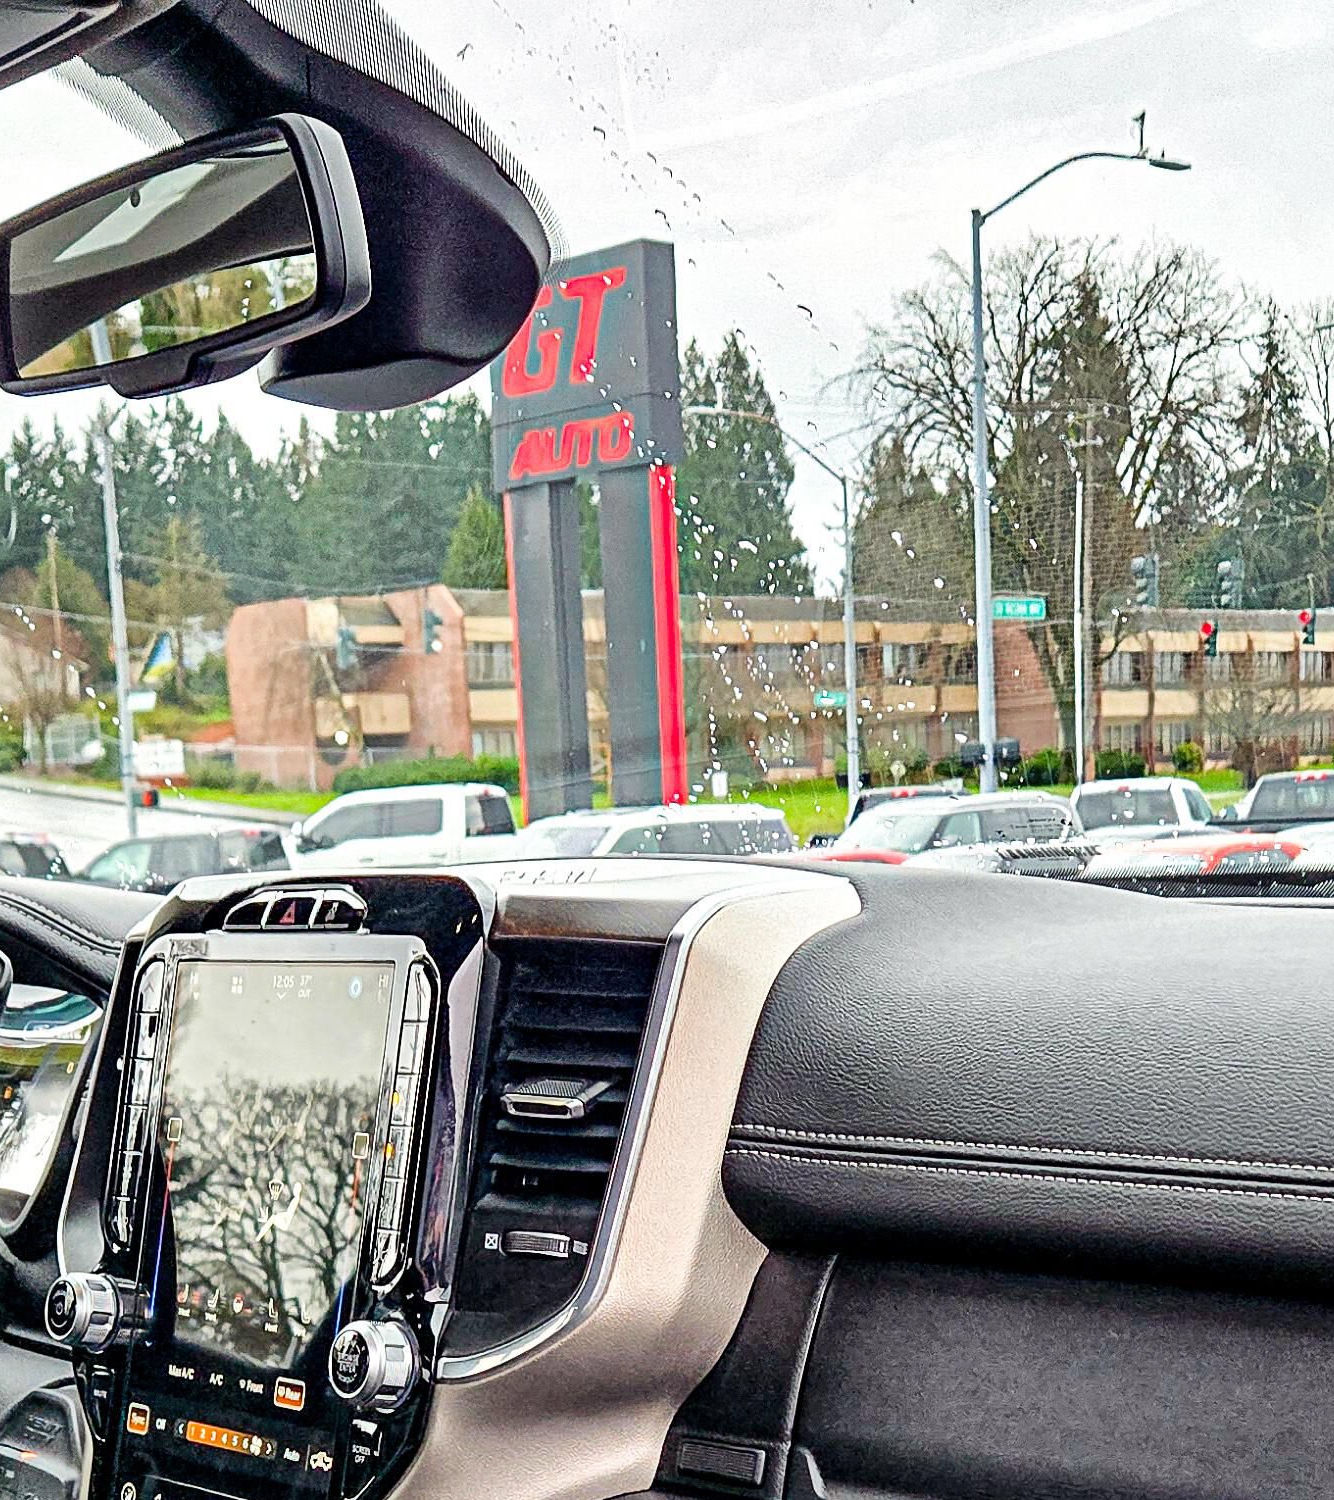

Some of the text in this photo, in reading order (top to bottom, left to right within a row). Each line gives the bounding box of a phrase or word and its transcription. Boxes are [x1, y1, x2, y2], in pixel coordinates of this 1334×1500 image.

[502, 265, 628, 398] GT
[508, 409, 636, 481] AUTO
[272, 974, 295, 989] 12:05
[209, 1373, 224, 1387] A/C
